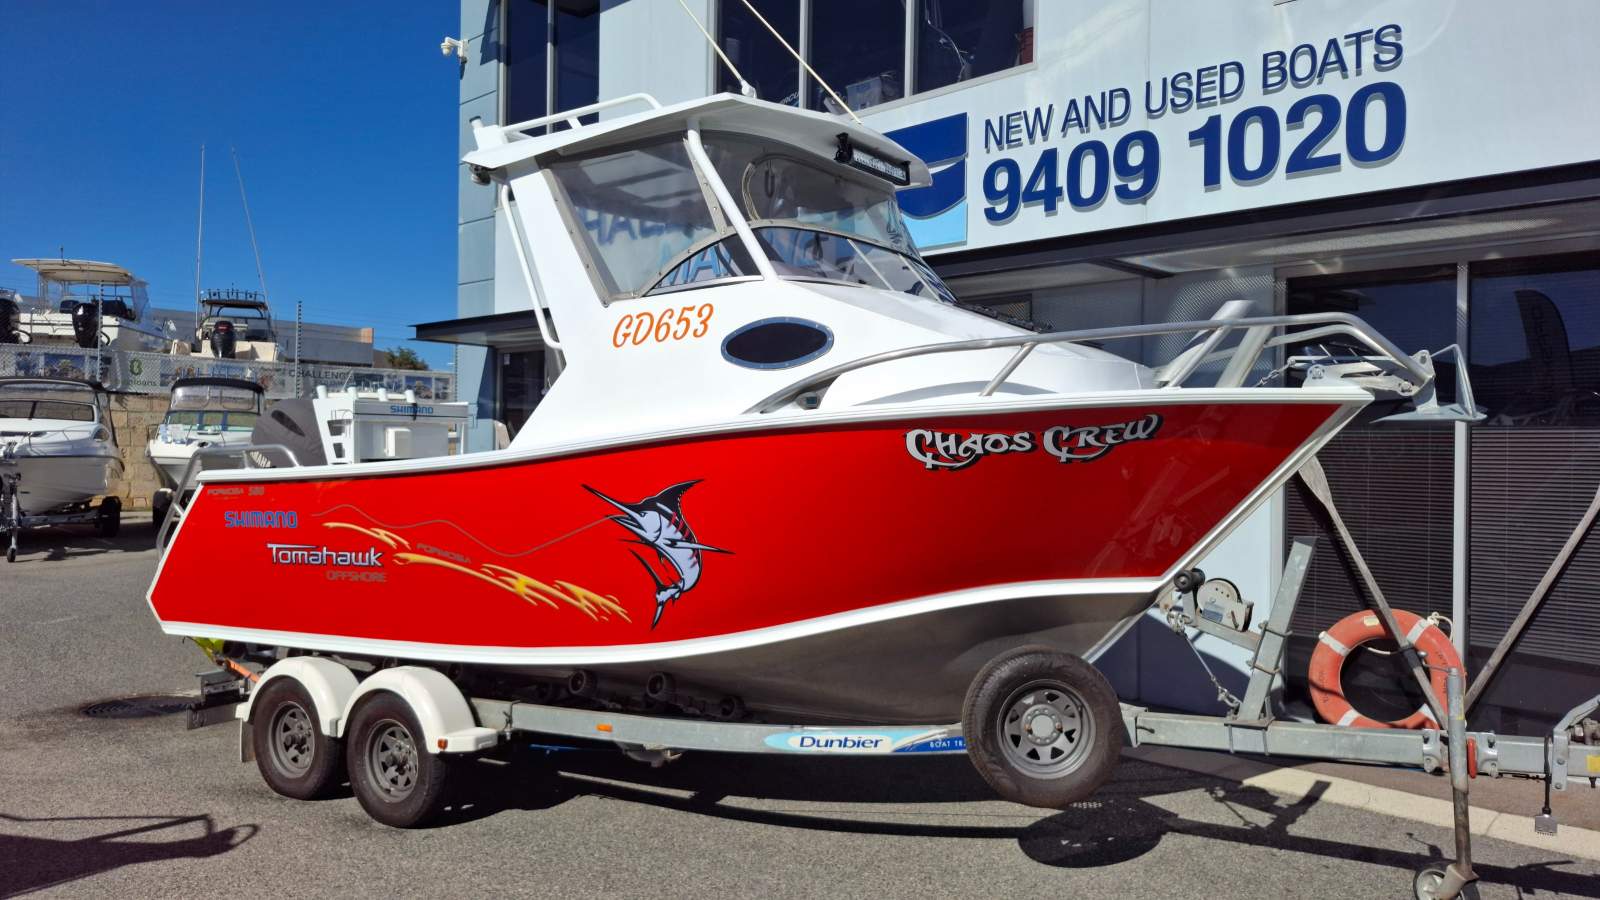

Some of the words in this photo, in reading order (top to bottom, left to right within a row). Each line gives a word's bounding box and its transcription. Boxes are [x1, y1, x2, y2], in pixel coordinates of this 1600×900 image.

[984, 103, 1054, 150] NEW
[1061, 87, 1131, 134] AND
[1145, 61, 1245, 118] USED
[1262, 24, 1403, 95] BOATS
[983, 130, 1160, 226] 9409
[1188, 81, 1407, 192] 1020
[611, 302, 714, 348] GD653
[905, 428, 1036, 471] CHAOS
[1042, 413, 1164, 463] CREW
[224, 511, 299, 529] SHIMANO
[267, 543, 384, 568] Tomahawk
[326, 570, 387, 583] OFFSHORE
[799, 736, 884, 748] Dunbier
[929, 740, 951, 748] BOAT
[954, 739, 967, 747] TR
